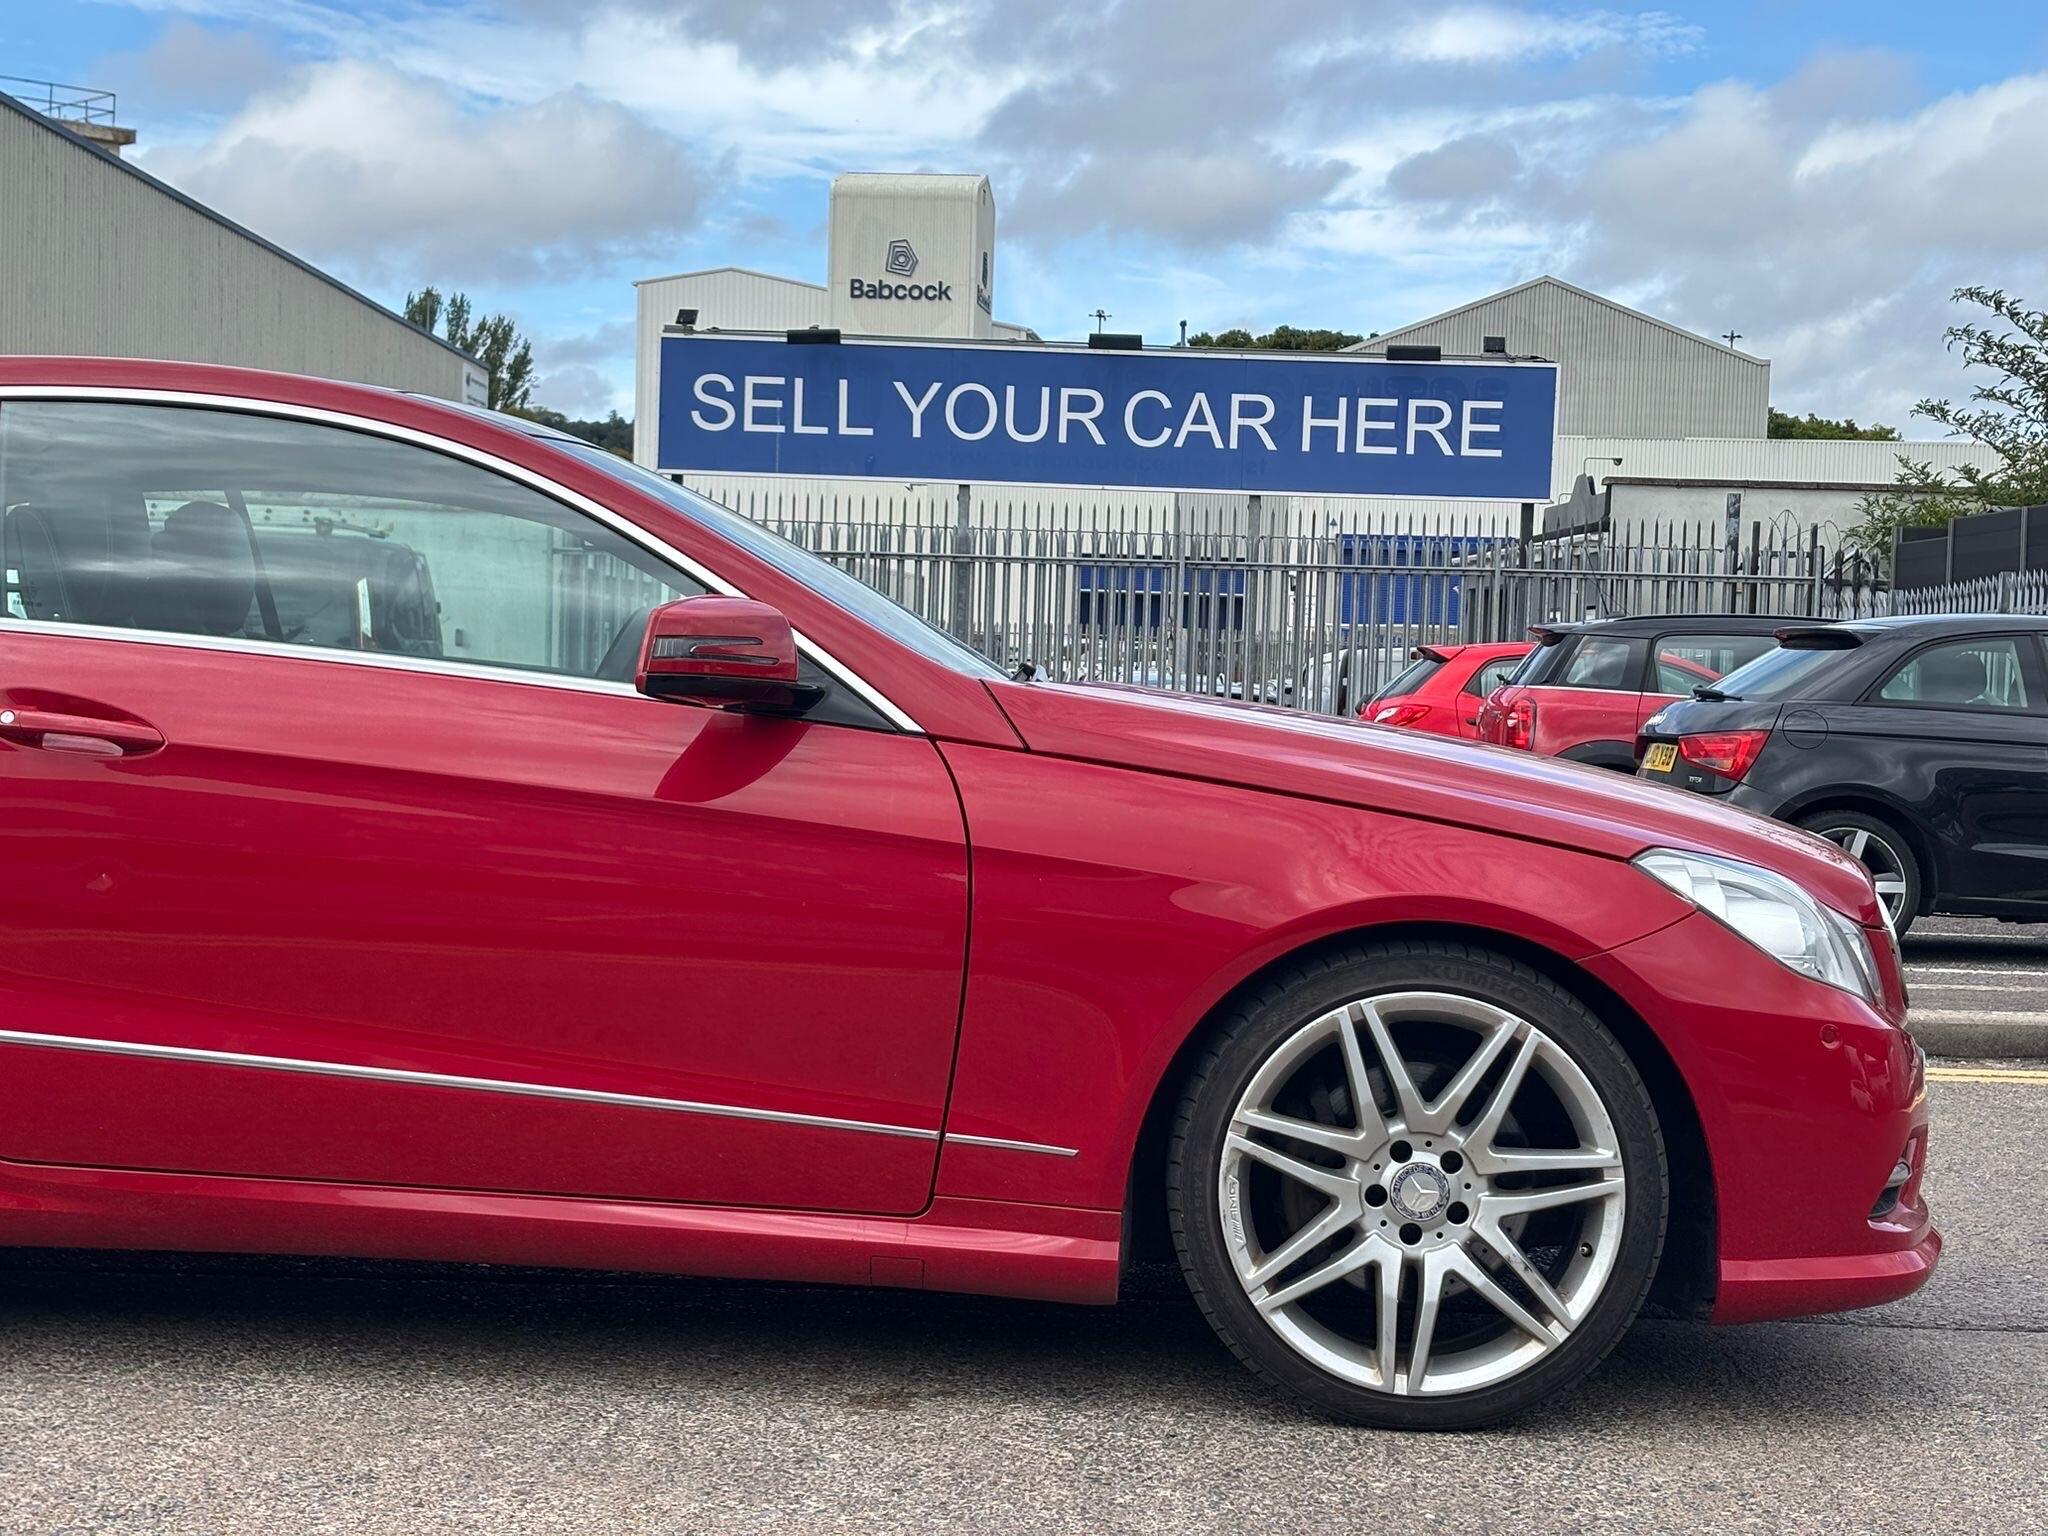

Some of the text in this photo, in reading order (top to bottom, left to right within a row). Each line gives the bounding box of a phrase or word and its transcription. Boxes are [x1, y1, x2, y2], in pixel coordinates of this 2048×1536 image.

[850, 278, 952, 301] Babcock
[691, 373, 874, 436] SELL
[893, 381, 1107, 445] YOUR
[1124, 389, 1278, 451] CAR
[1301, 395, 1504, 458] HERE
[1425, 963, 1529, 1001] KUMHO
